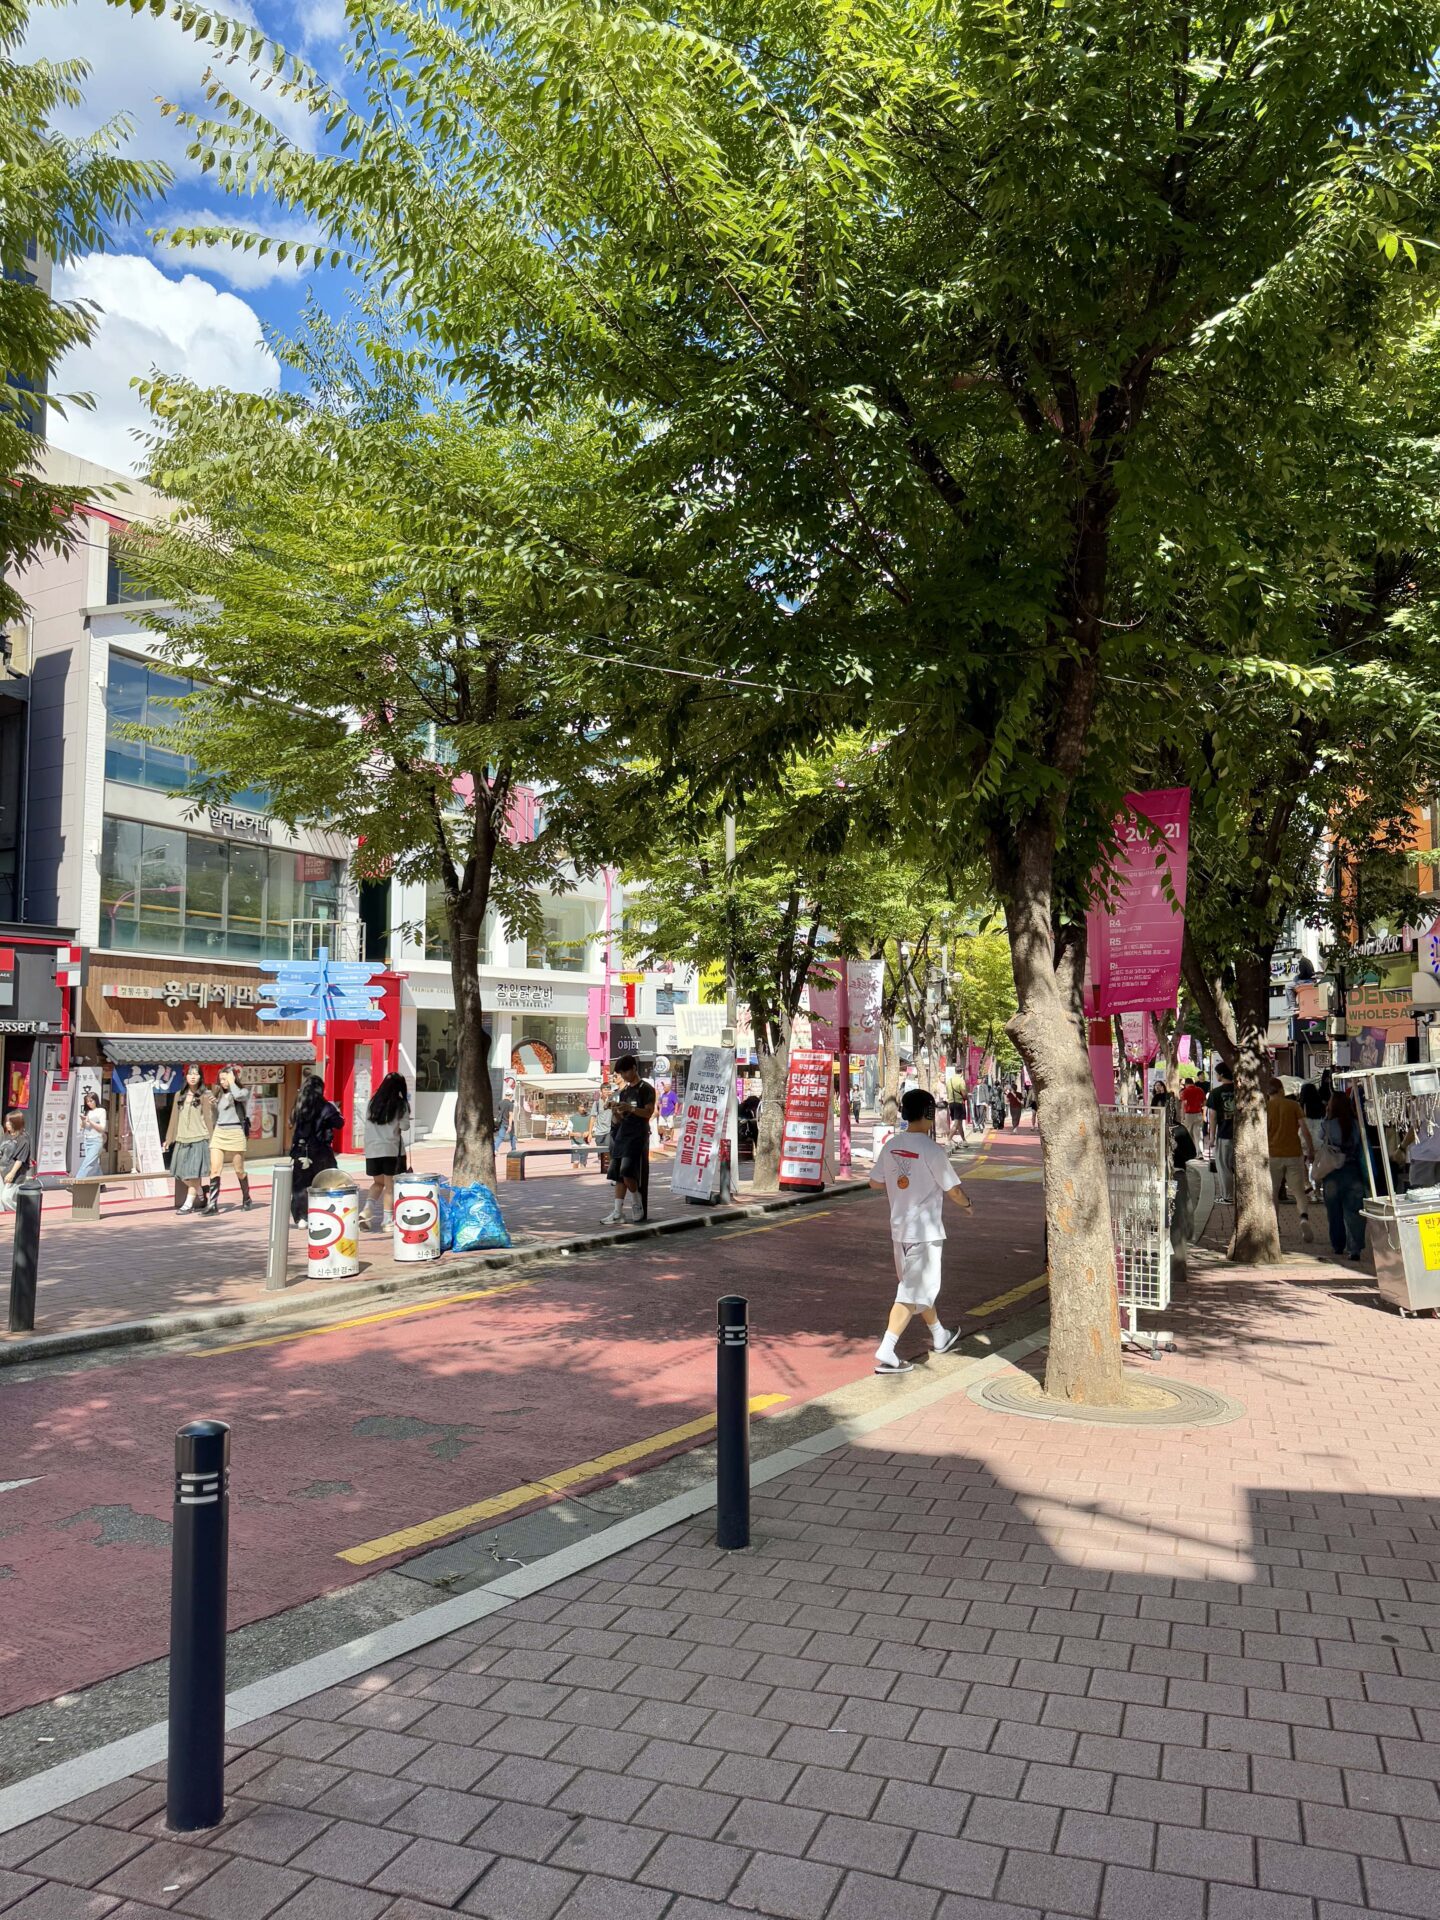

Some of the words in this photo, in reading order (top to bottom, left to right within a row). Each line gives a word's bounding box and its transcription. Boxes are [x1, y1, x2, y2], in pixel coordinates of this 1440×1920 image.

[1110, 938, 1121, 946] R5
[1375, 936, 1400, 954] BAR
[497, 983, 553, 1000] 장인닭갈비
[1348, 1008, 1413, 1021] WHOLESA
[617, 1040, 641, 1050] OBJET
[791, 1073, 829, 1086] 민생회복
[790, 1085, 828, 1097] 소비쿠폰
[680, 1105, 702, 1166] 예술인들
